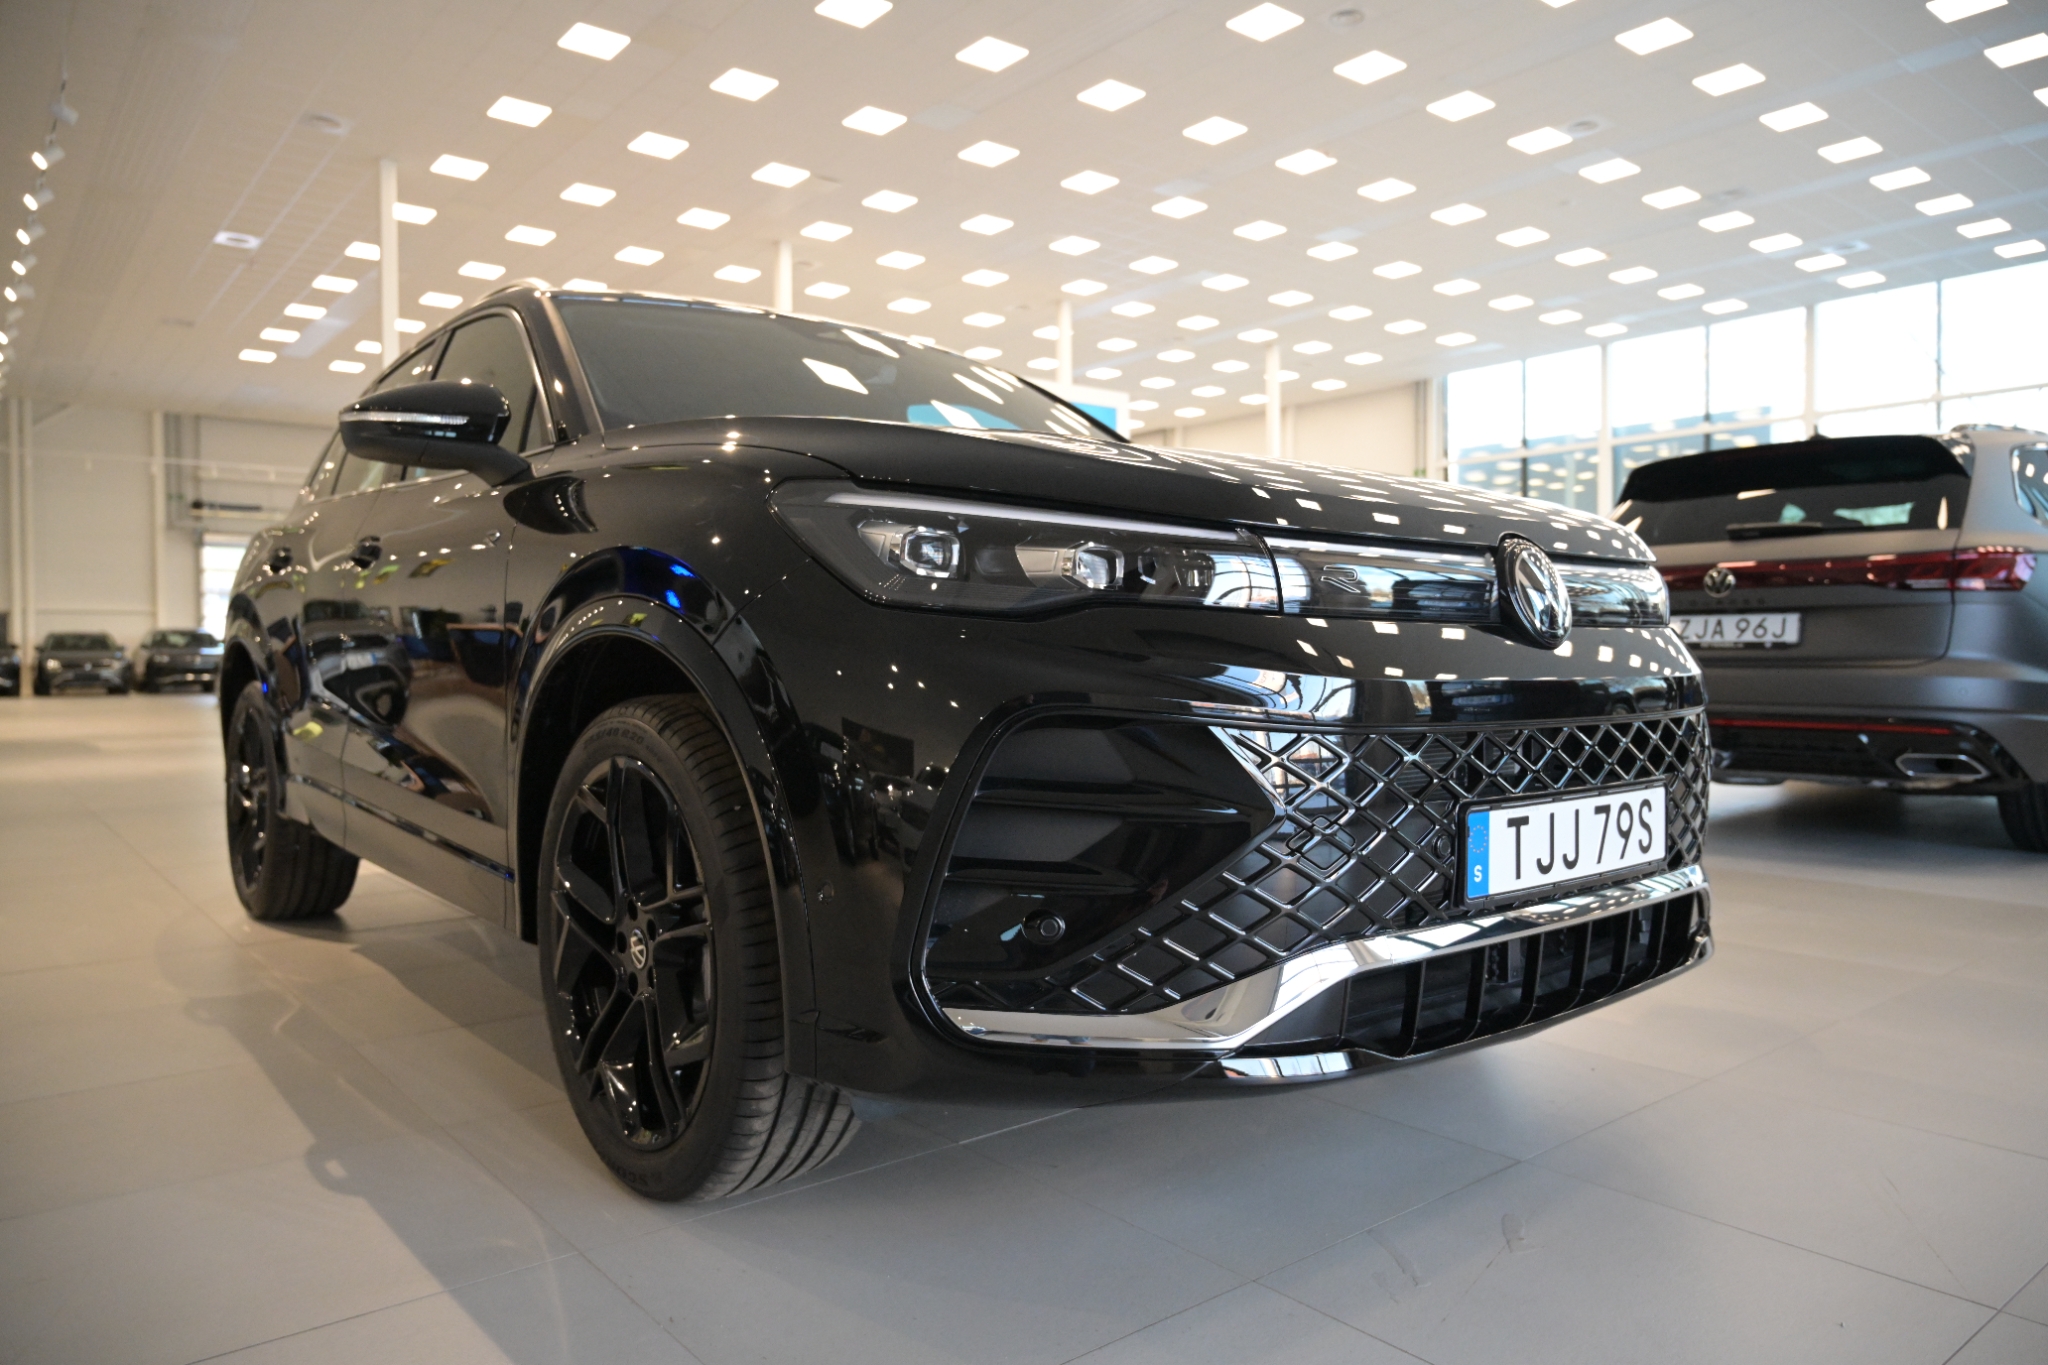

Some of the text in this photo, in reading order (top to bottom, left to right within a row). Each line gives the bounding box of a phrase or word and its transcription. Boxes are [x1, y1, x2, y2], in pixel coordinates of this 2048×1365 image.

[1321, 564, 1361, 593] R
[1679, 617, 1787, 640] ZJA 96J
[1507, 798, 1653, 880] TJJ 79S
[1473, 864, 1483, 883] S
